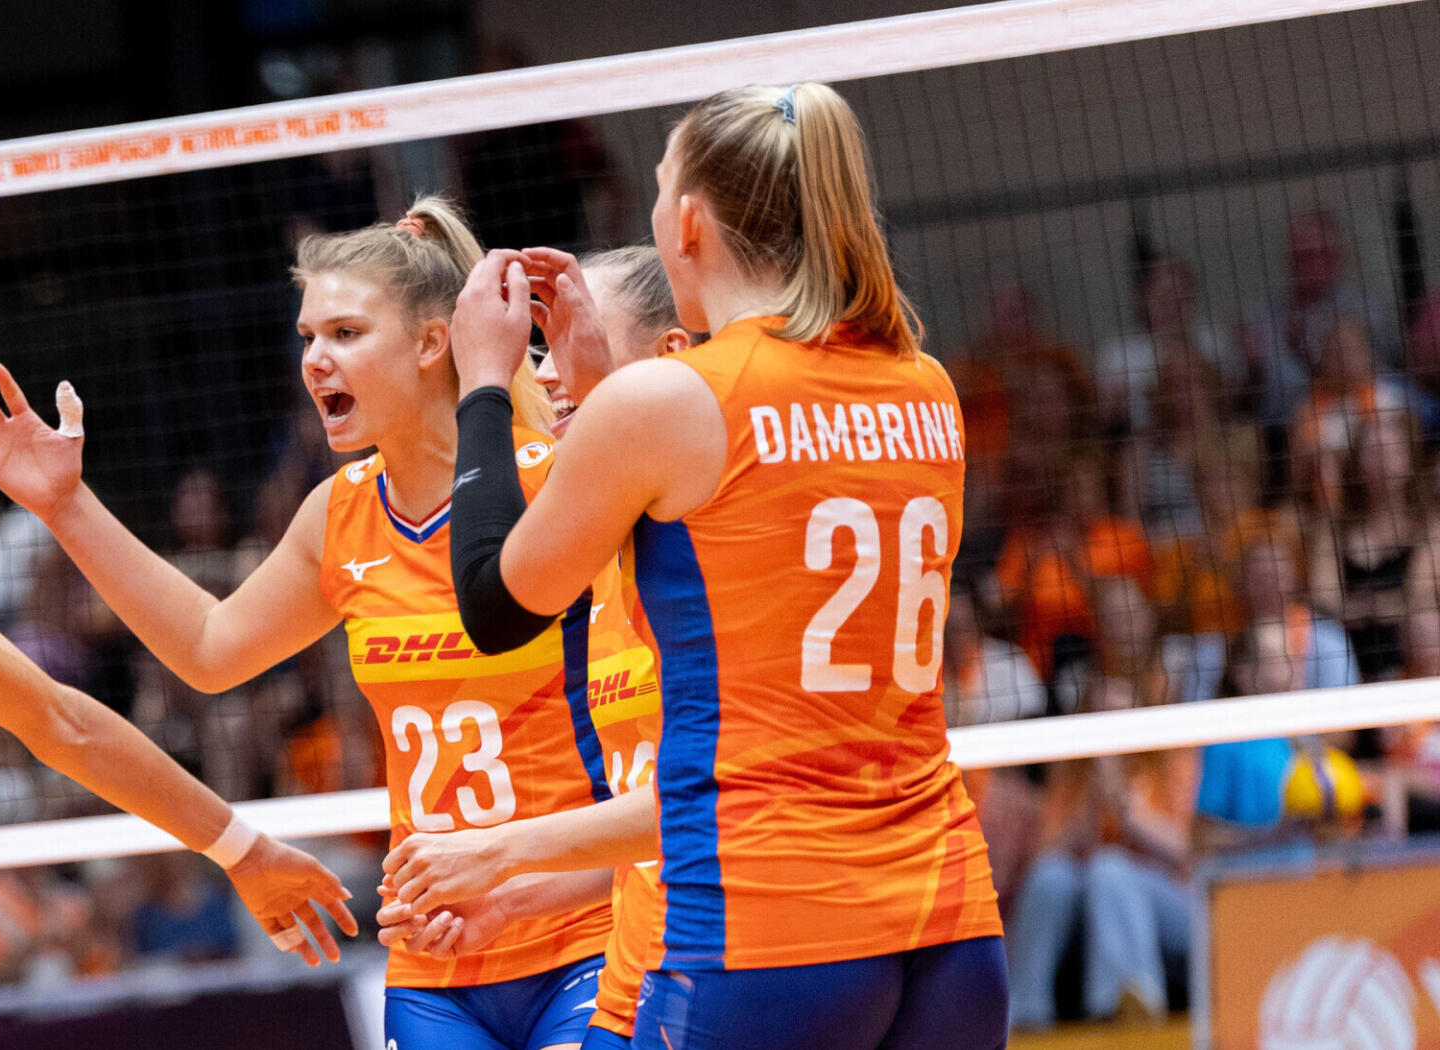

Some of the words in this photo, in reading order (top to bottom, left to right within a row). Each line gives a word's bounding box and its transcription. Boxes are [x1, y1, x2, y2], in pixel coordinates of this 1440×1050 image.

[750, 402, 964, 464] DAMBRINK
[800, 496, 948, 694] 26
[364, 632, 477, 665] DHL
[391, 700, 516, 832] 23
